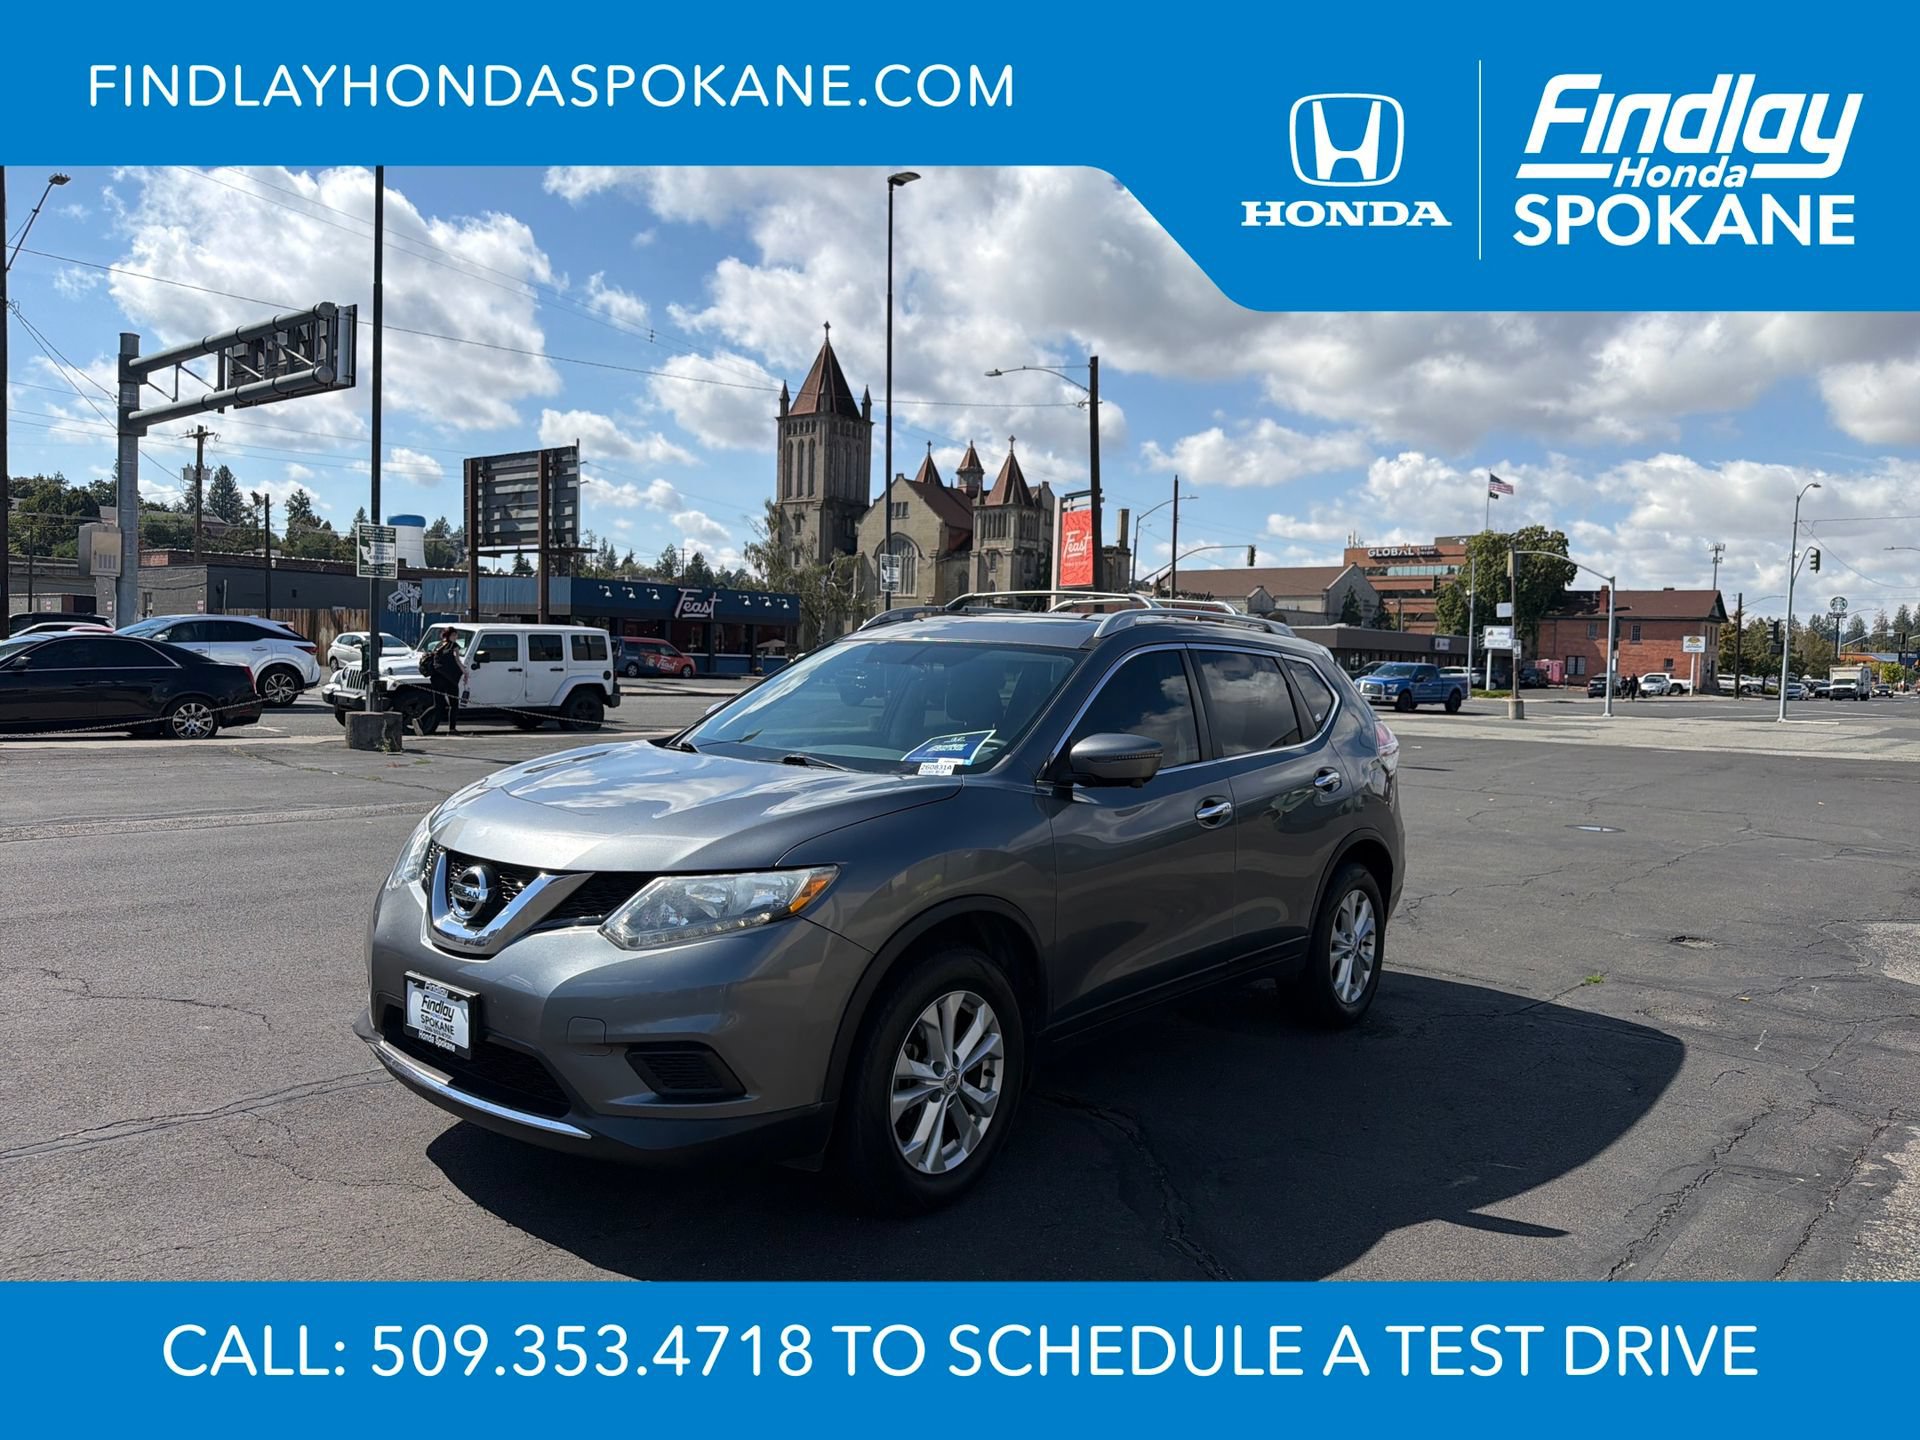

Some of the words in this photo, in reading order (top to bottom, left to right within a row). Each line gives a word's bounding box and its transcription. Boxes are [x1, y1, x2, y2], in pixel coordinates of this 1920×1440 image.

[1063, 529, 1093, 559] Feast
[1367, 546, 1415, 557] GLOBAL
[674, 587, 722, 620] Feast
[421, 995, 455, 1022] Findlay
[418, 1029, 435, 1045] Honda
[420, 1014, 455, 1036] SPOKANE
